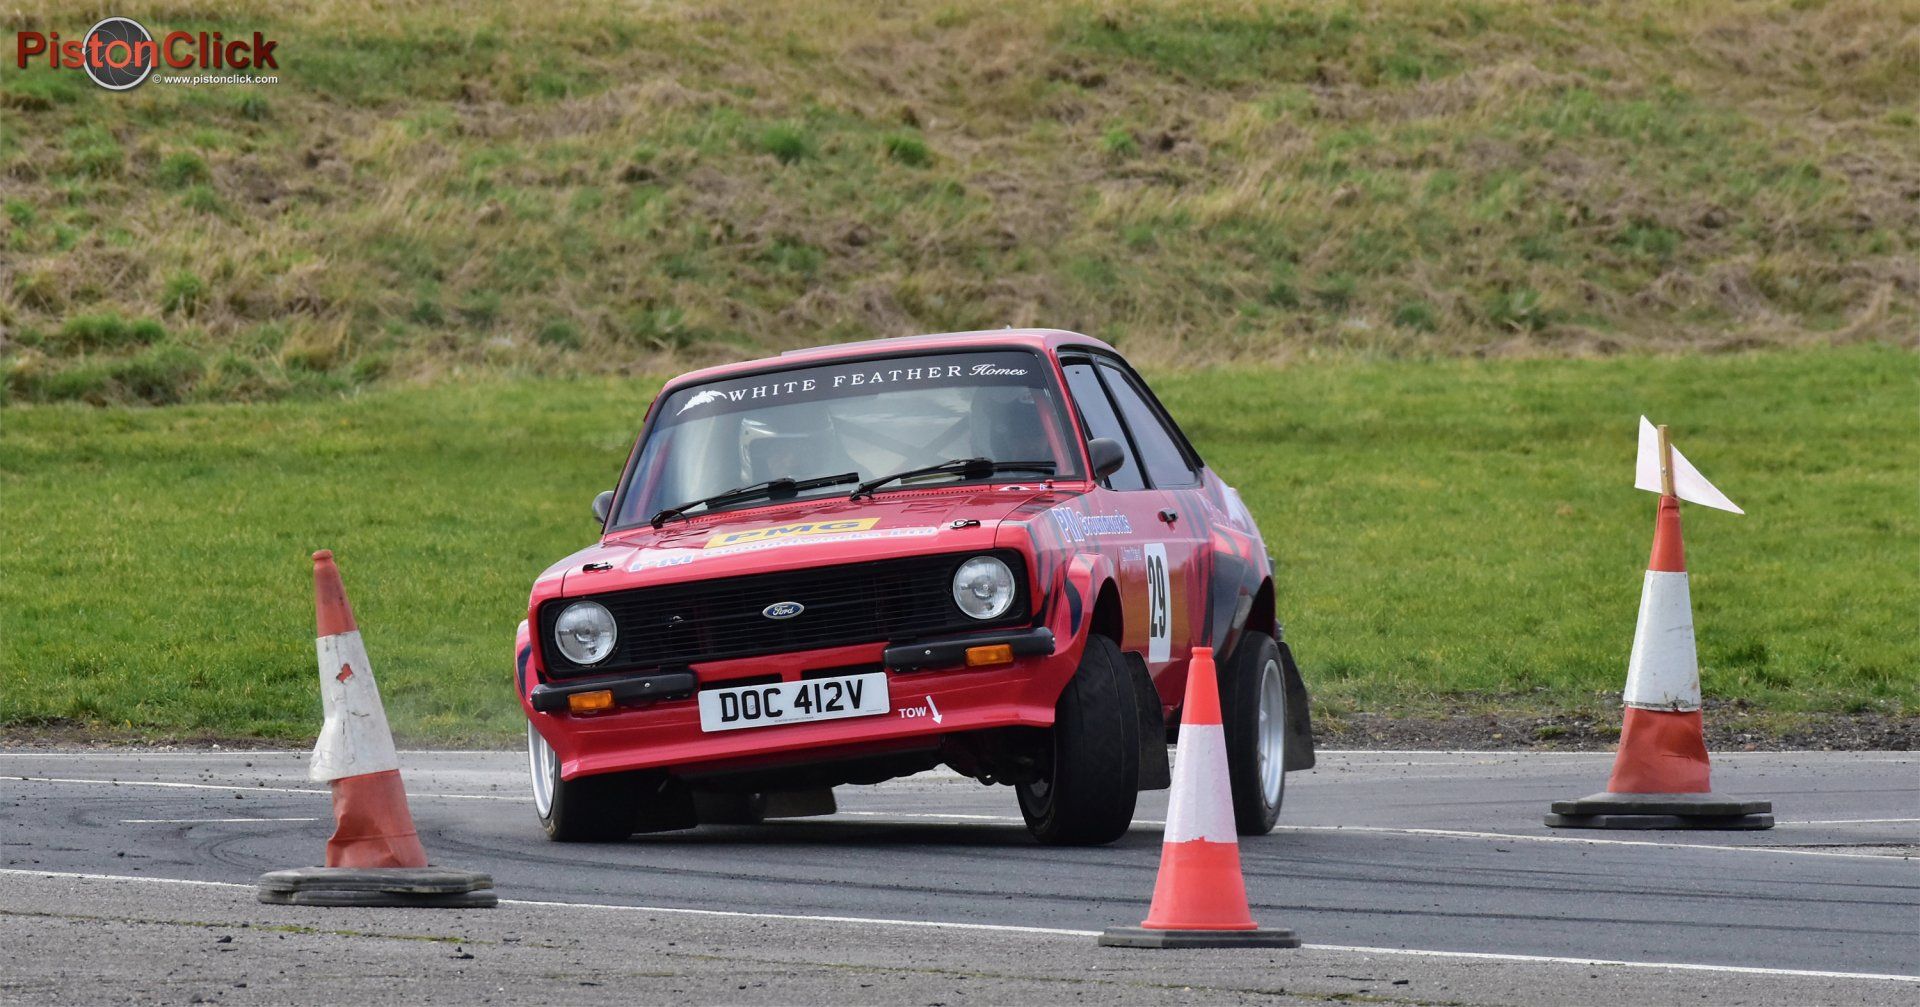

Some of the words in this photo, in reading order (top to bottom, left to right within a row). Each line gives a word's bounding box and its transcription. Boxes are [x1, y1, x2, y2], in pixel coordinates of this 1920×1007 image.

[728, 379, 816, 402] WHITE
[833, 365, 962, 388] FEATHER
[968, 363, 1028, 377] Homes
[723, 521, 860, 543] PMG
[1052, 507, 1085, 543] PM
[772, 603, 794, 616] Ford
[1147, 554, 1166, 639] 29
[719, 687, 783, 723] DOC
[793, 679, 863, 715] 412V
[898, 706, 927, 719] TOW
